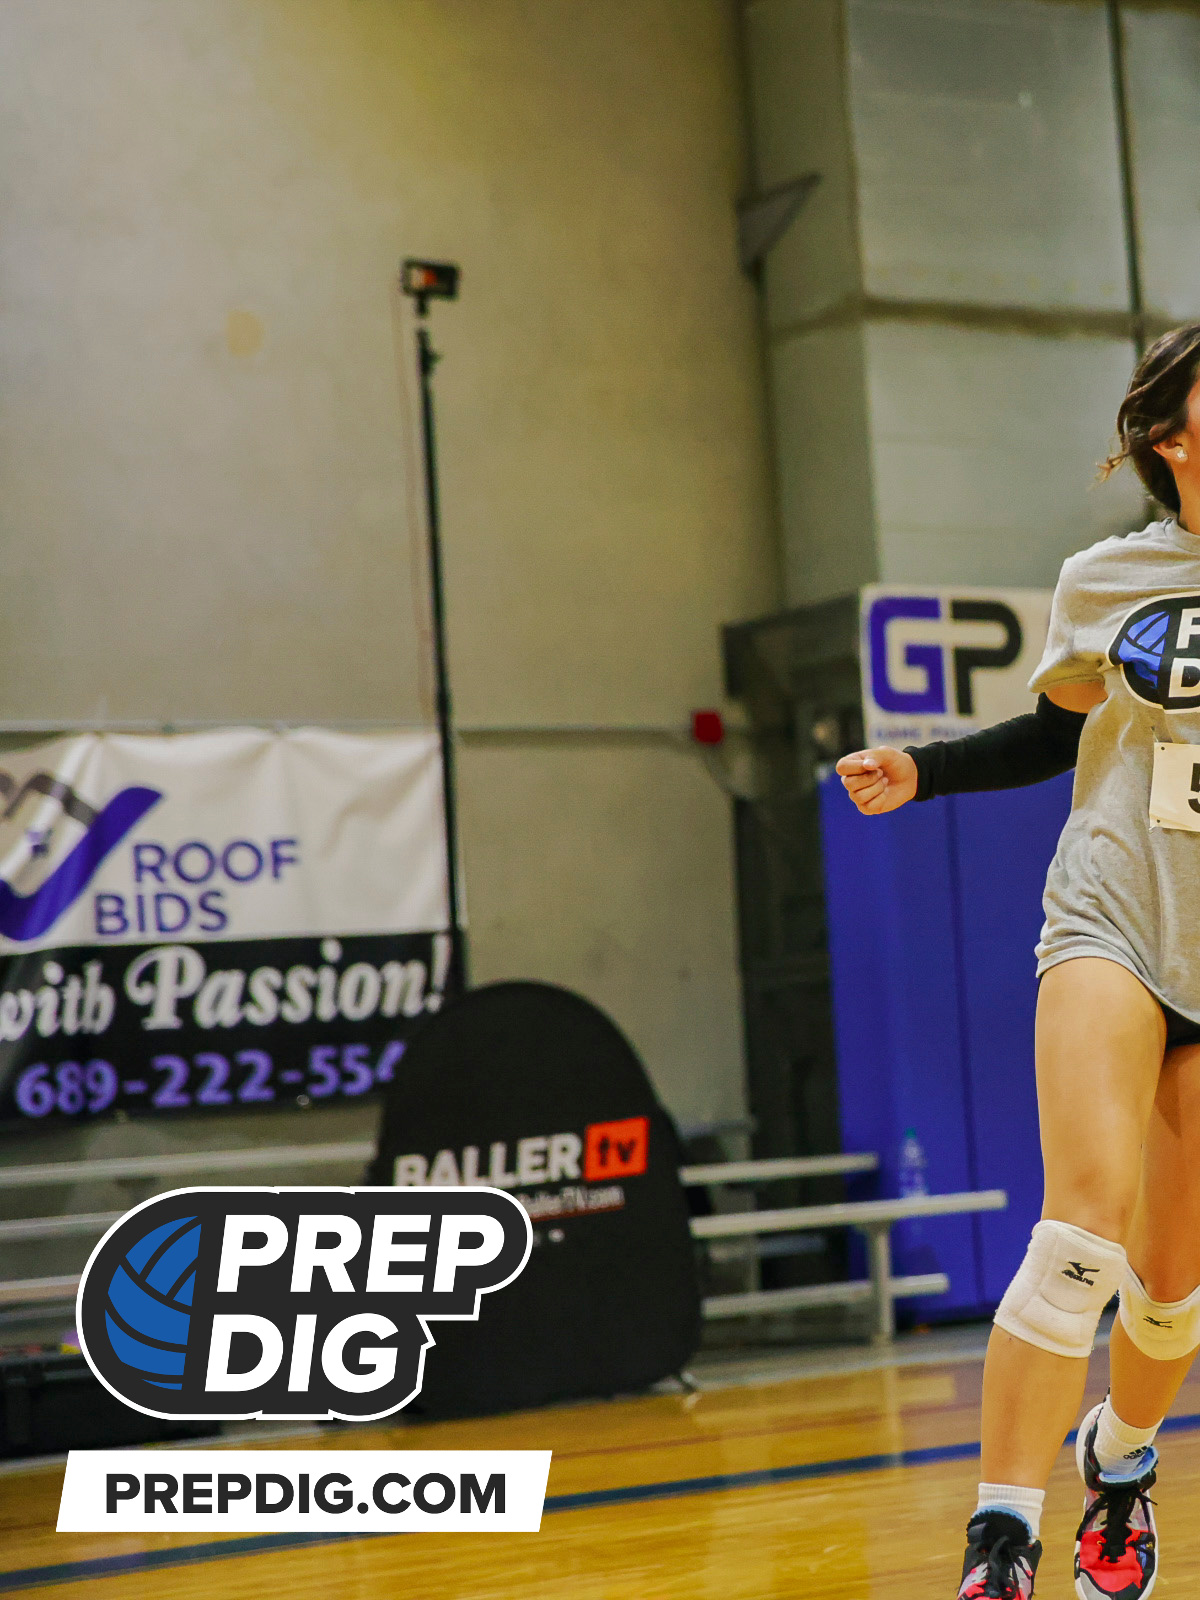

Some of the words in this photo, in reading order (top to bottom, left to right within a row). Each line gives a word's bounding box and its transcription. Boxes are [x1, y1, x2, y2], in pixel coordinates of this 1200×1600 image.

[133, 838, 299, 885] ROOF
[94, 890, 230, 936] BIDS
[124, 934, 452, 1030] Passion!
[393, 1132, 582, 1188] BALLER
